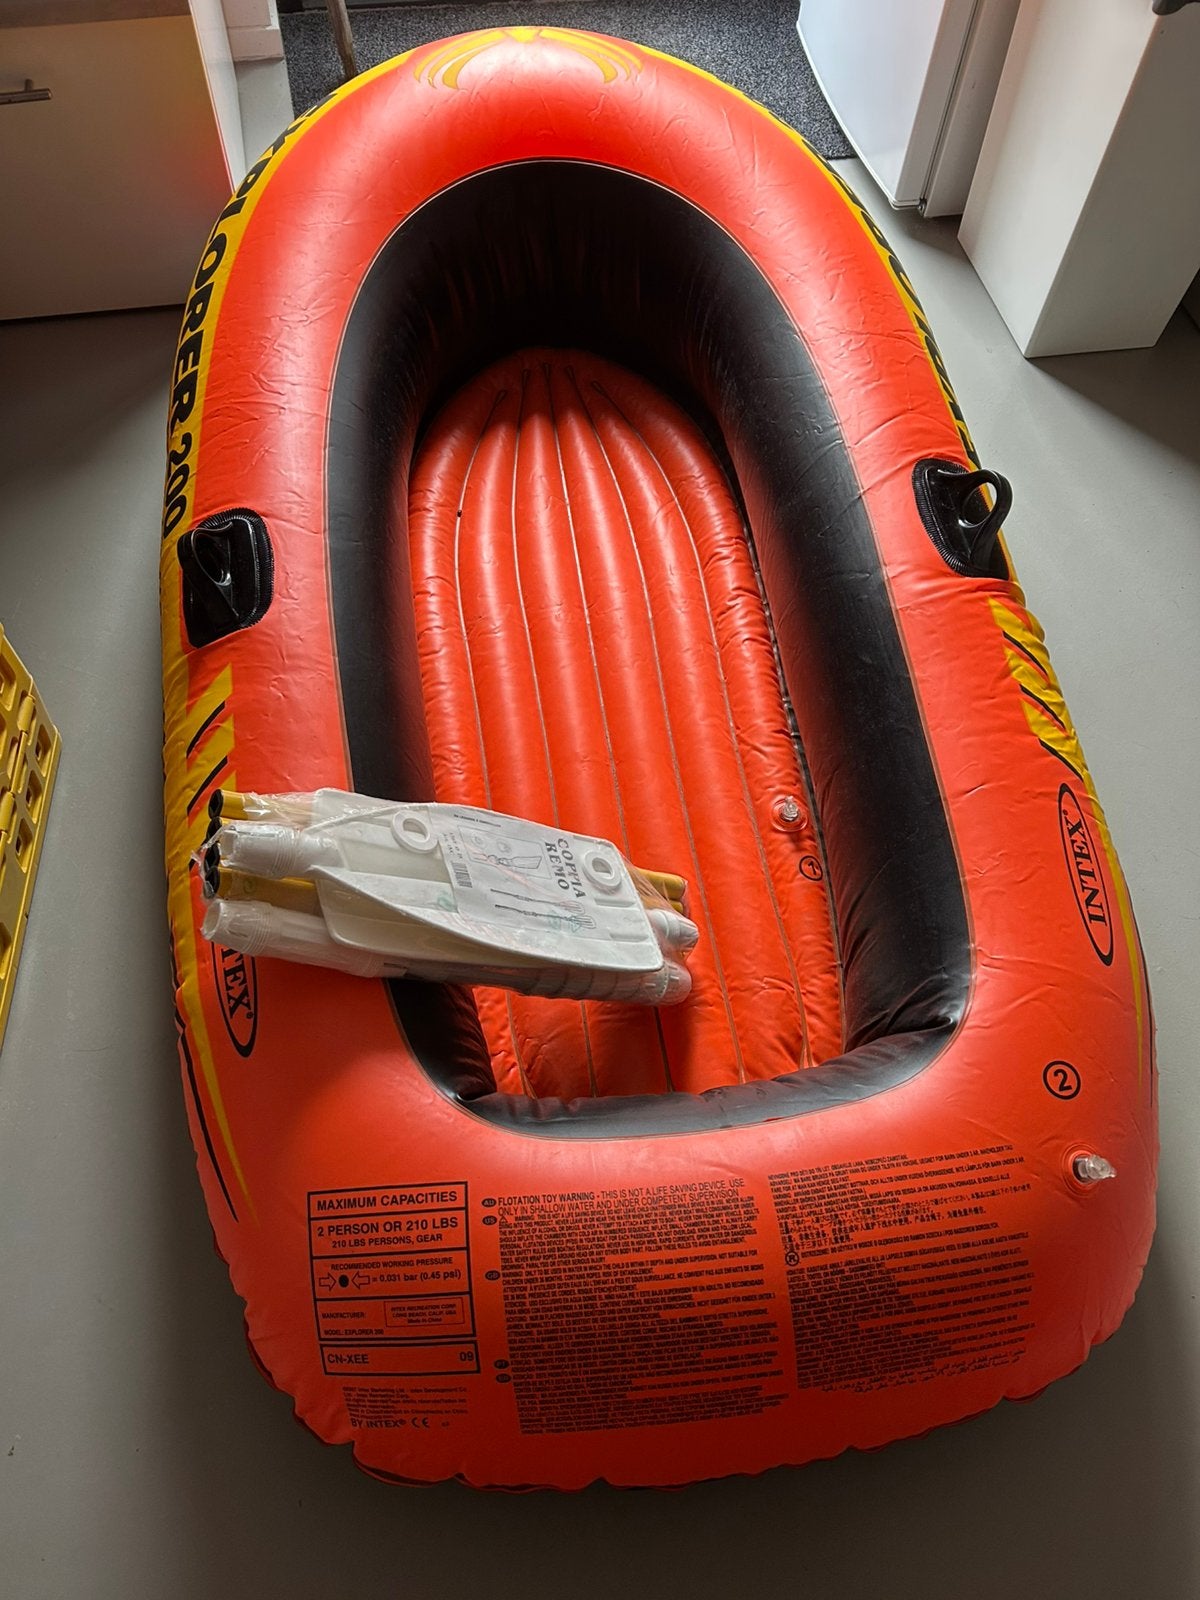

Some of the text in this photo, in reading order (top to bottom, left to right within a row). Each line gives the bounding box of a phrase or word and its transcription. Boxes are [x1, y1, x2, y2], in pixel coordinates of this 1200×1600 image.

[163, 93, 338, 539] XPLORER 200
[544, 841, 570, 891] REMO
[557, 838, 586, 898] COPPIA
[221, 948, 252, 1019] TEX
[317, 1191, 457, 1211] MAXIMUM CAPACITIES
[498, 1195, 540, 1206] FLOTATION
[542, 1194, 557, 1203] TOY
[559, 1191, 594, 1202] WARNING
[602, 1190, 618, 1200] THIS
[620, 1189, 627, 1198] IS
[628, 1187, 644, 1198] NOT
[646, 1187, 652, 1196] A
[653, 1185, 668, 1195] LIFE
[670, 1183, 698, 1194] SAVING
[730, 1178, 745, 1188] USE
[498, 1206, 518, 1216] ONLY
[521, 1206, 528, 1215] IN
[530, 1203, 566, 1214] SHALLOW
[568, 1201, 594, 1212] WATER
[596, 1199, 612, 1209] AND
[614, 1197, 640, 1208] UNDER
[641, 1193, 688, 1206] COMPETENT
[689, 1188, 740, 1201] SUPERVISION
[317, 1217, 459, 1237] 2 PERSON OR 210 LBS
[332, 1233, 443, 1249] 210 LBS PERSONS, GEAR
[330, 1257, 453, 1271] RECOMMENDED WORKING PRESSURE
[379, 1273, 401, 1282] 0.031
[403, 1271, 418, 1282] bar
[419, 1270, 441, 1282] (0.45
[443, 1269, 461, 1281] psi)
[327, 1353, 370, 1364] CN-XEE
[351, 1417, 363, 1428] BY
